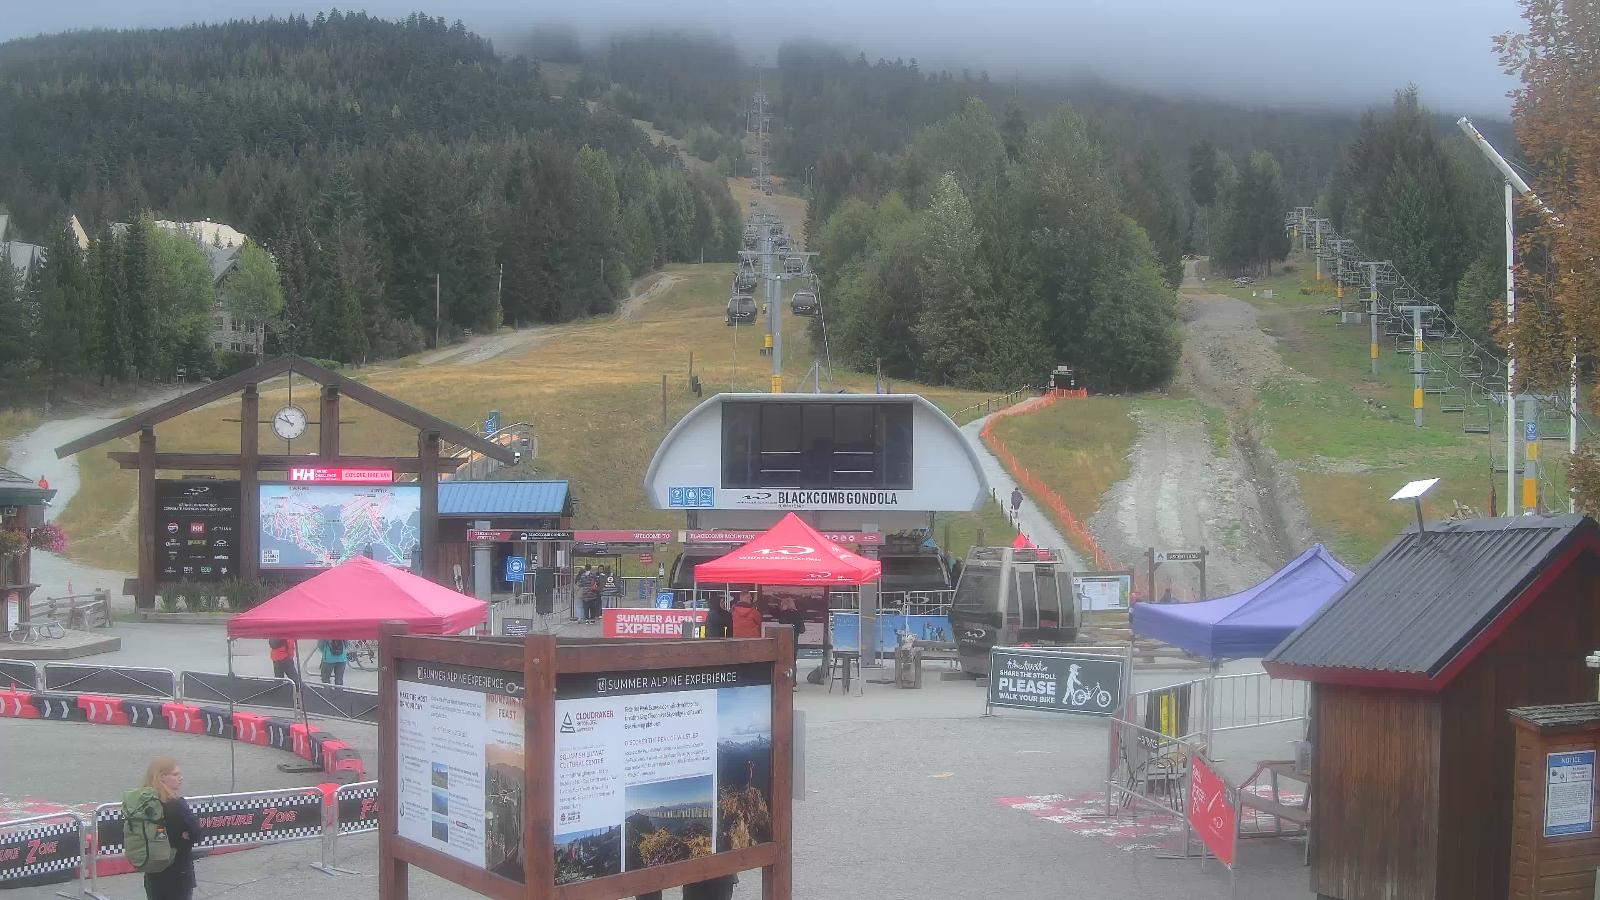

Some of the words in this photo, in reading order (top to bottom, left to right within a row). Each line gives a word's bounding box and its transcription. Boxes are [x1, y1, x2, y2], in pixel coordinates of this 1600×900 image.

[292, 468, 315, 481] HH
[778, 491, 845, 504] BLACKCOMB
[846, 492, 898, 505] GONDOLA
[616, 614, 662, 623] SUMMER
[665, 615, 703, 623] ALPINE
[615, 623, 683, 635] EXPERIEN
[608, 677, 648, 690] SUMMER
[650, 675, 683, 688] ALPINE
[685, 671, 737, 685] EXPERIENCE
[999, 669, 1019, 677] SHARE
[1032, 672, 1057, 680] STROLL
[998, 677, 1056, 696] PLEASE
[998, 692, 1018, 700] WALK
[1019, 694, 1038, 702] YOUR
[1039, 696, 1056, 704] BIKE
[498, 708, 517, 721] FEAST
[575, 710, 614, 721] CLOUDRAKER
[1561, 756, 1582, 764] NOTICE
[199, 813, 255, 828] DVENTURE
